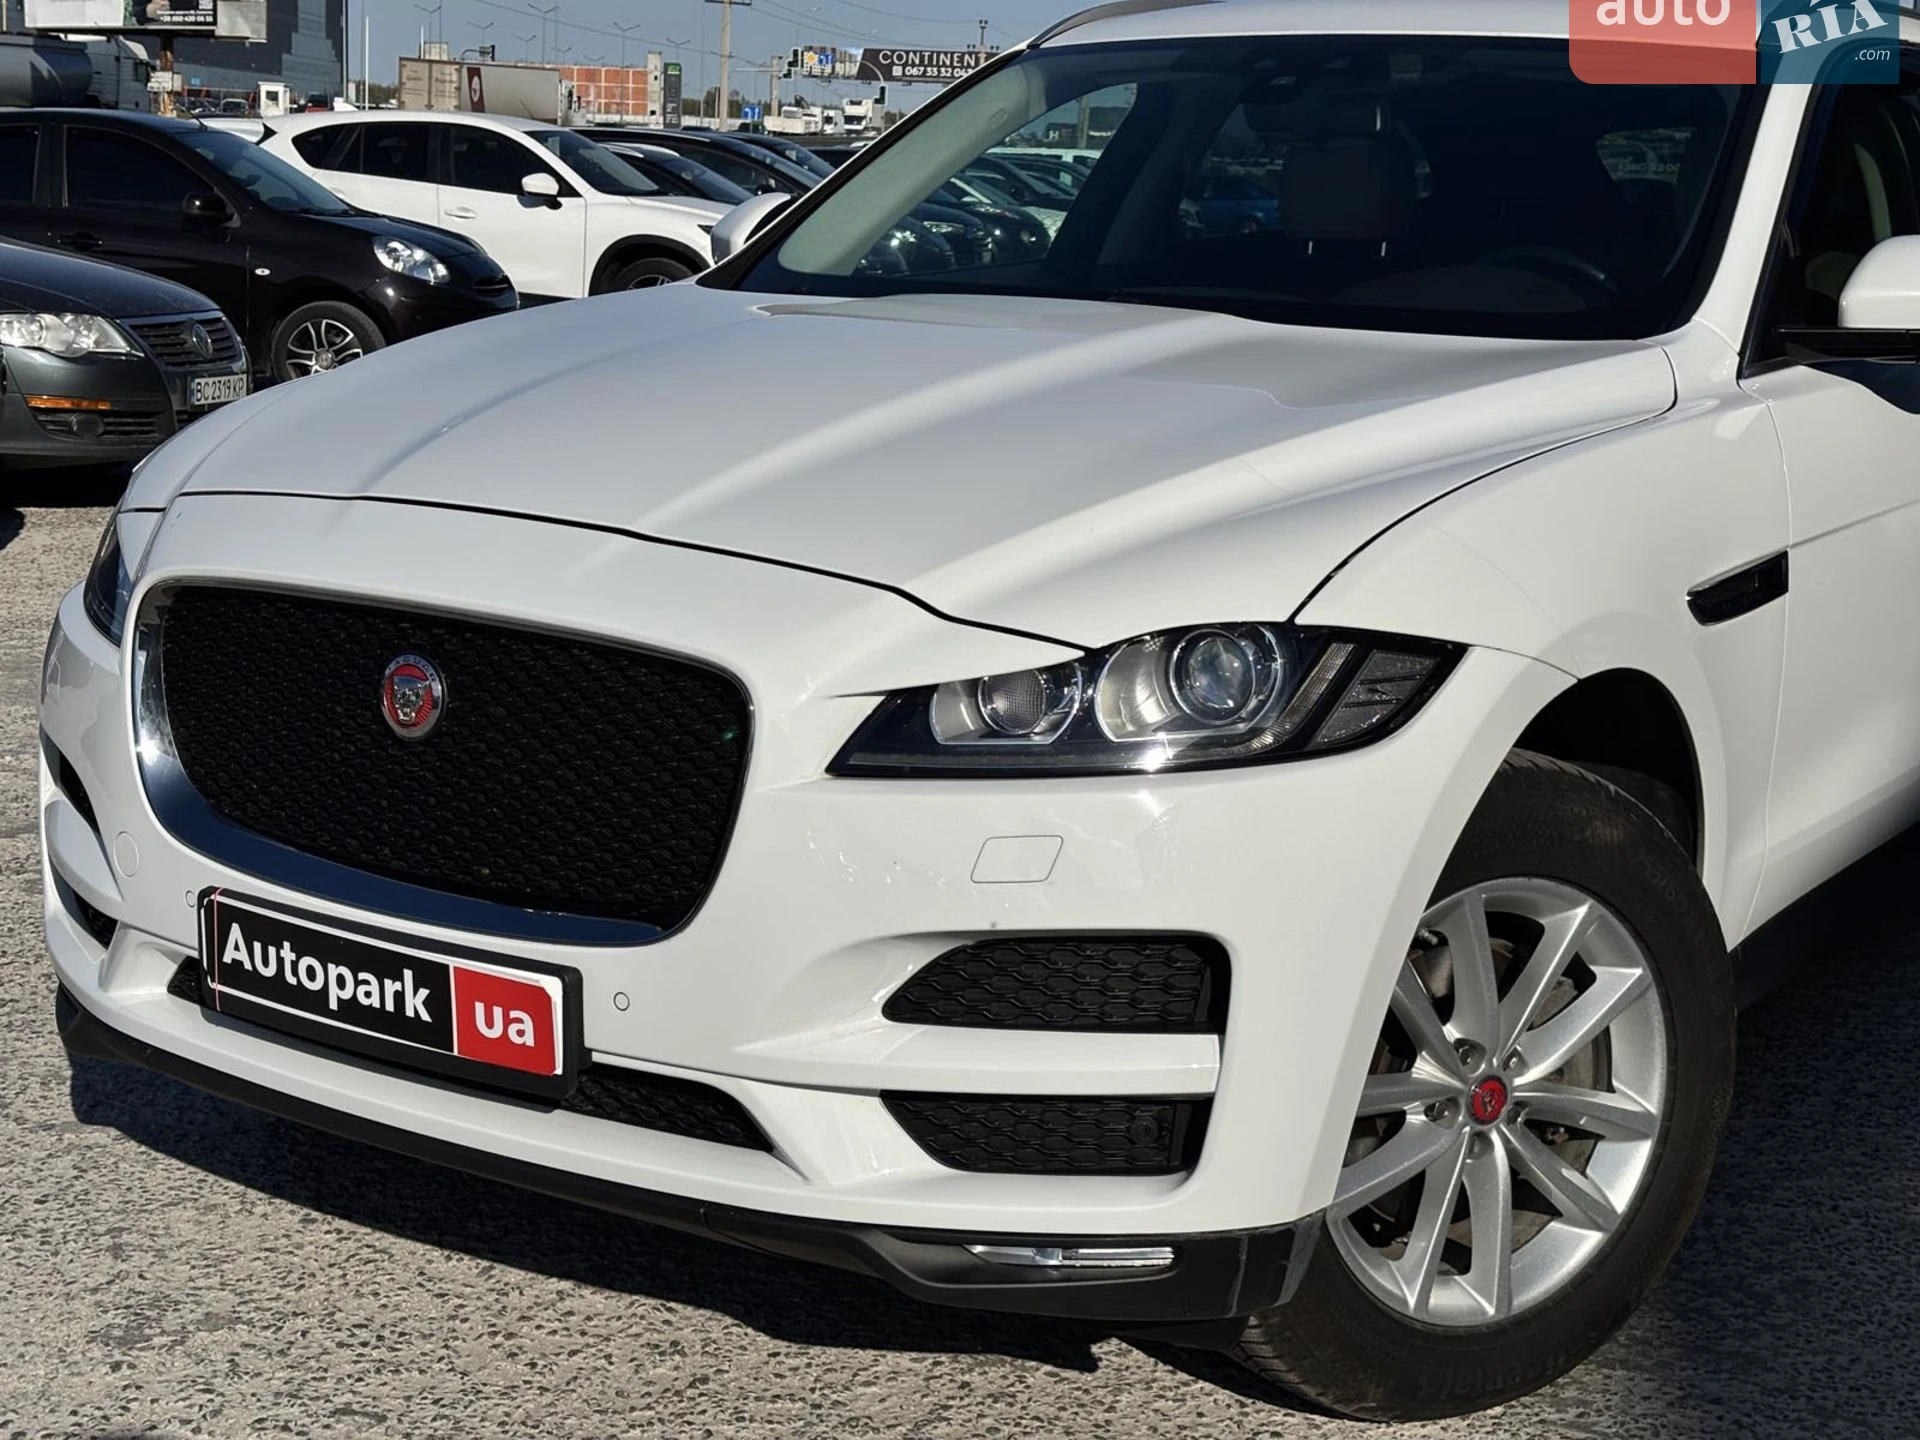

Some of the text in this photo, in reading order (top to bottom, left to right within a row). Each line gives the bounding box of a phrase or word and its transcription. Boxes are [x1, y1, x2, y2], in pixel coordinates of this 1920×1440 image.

[879, 50, 987, 66] CONTINENT
[905, 66, 924, 76] 067
[926, 67, 938, 76] 33
[939, 68, 952, 76] 32
[196, 377, 245, 403] BC 2319 KP
[222, 922, 535, 1047] Autopark ua
